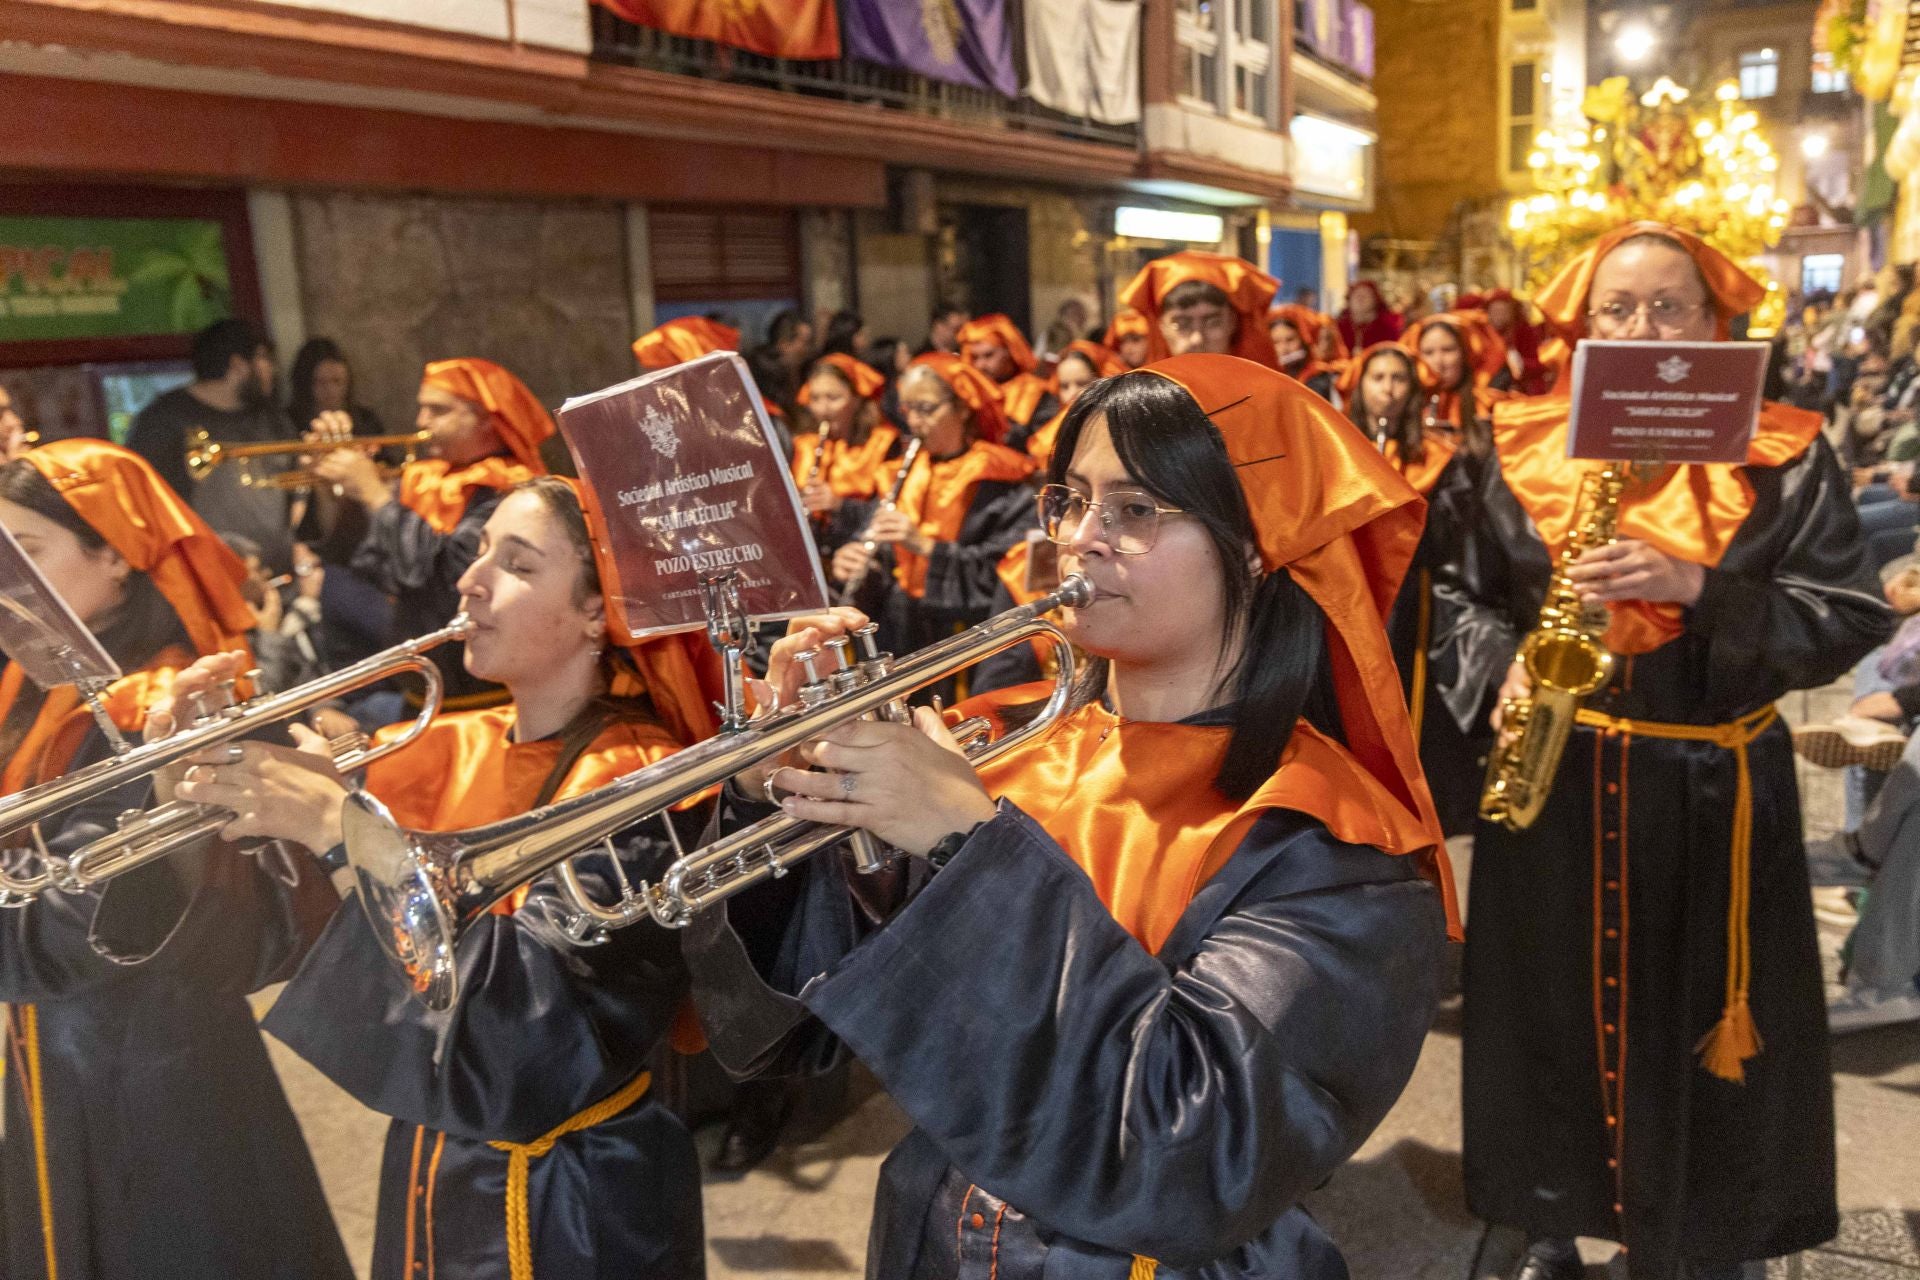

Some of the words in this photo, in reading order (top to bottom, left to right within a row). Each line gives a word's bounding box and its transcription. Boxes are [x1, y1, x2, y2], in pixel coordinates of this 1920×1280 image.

[617, 481, 664, 507] Sociedad
[709, 460, 754, 486] Musical
[655, 555, 690, 576] POZO
[690, 543, 764, 570] ESTRECHO
